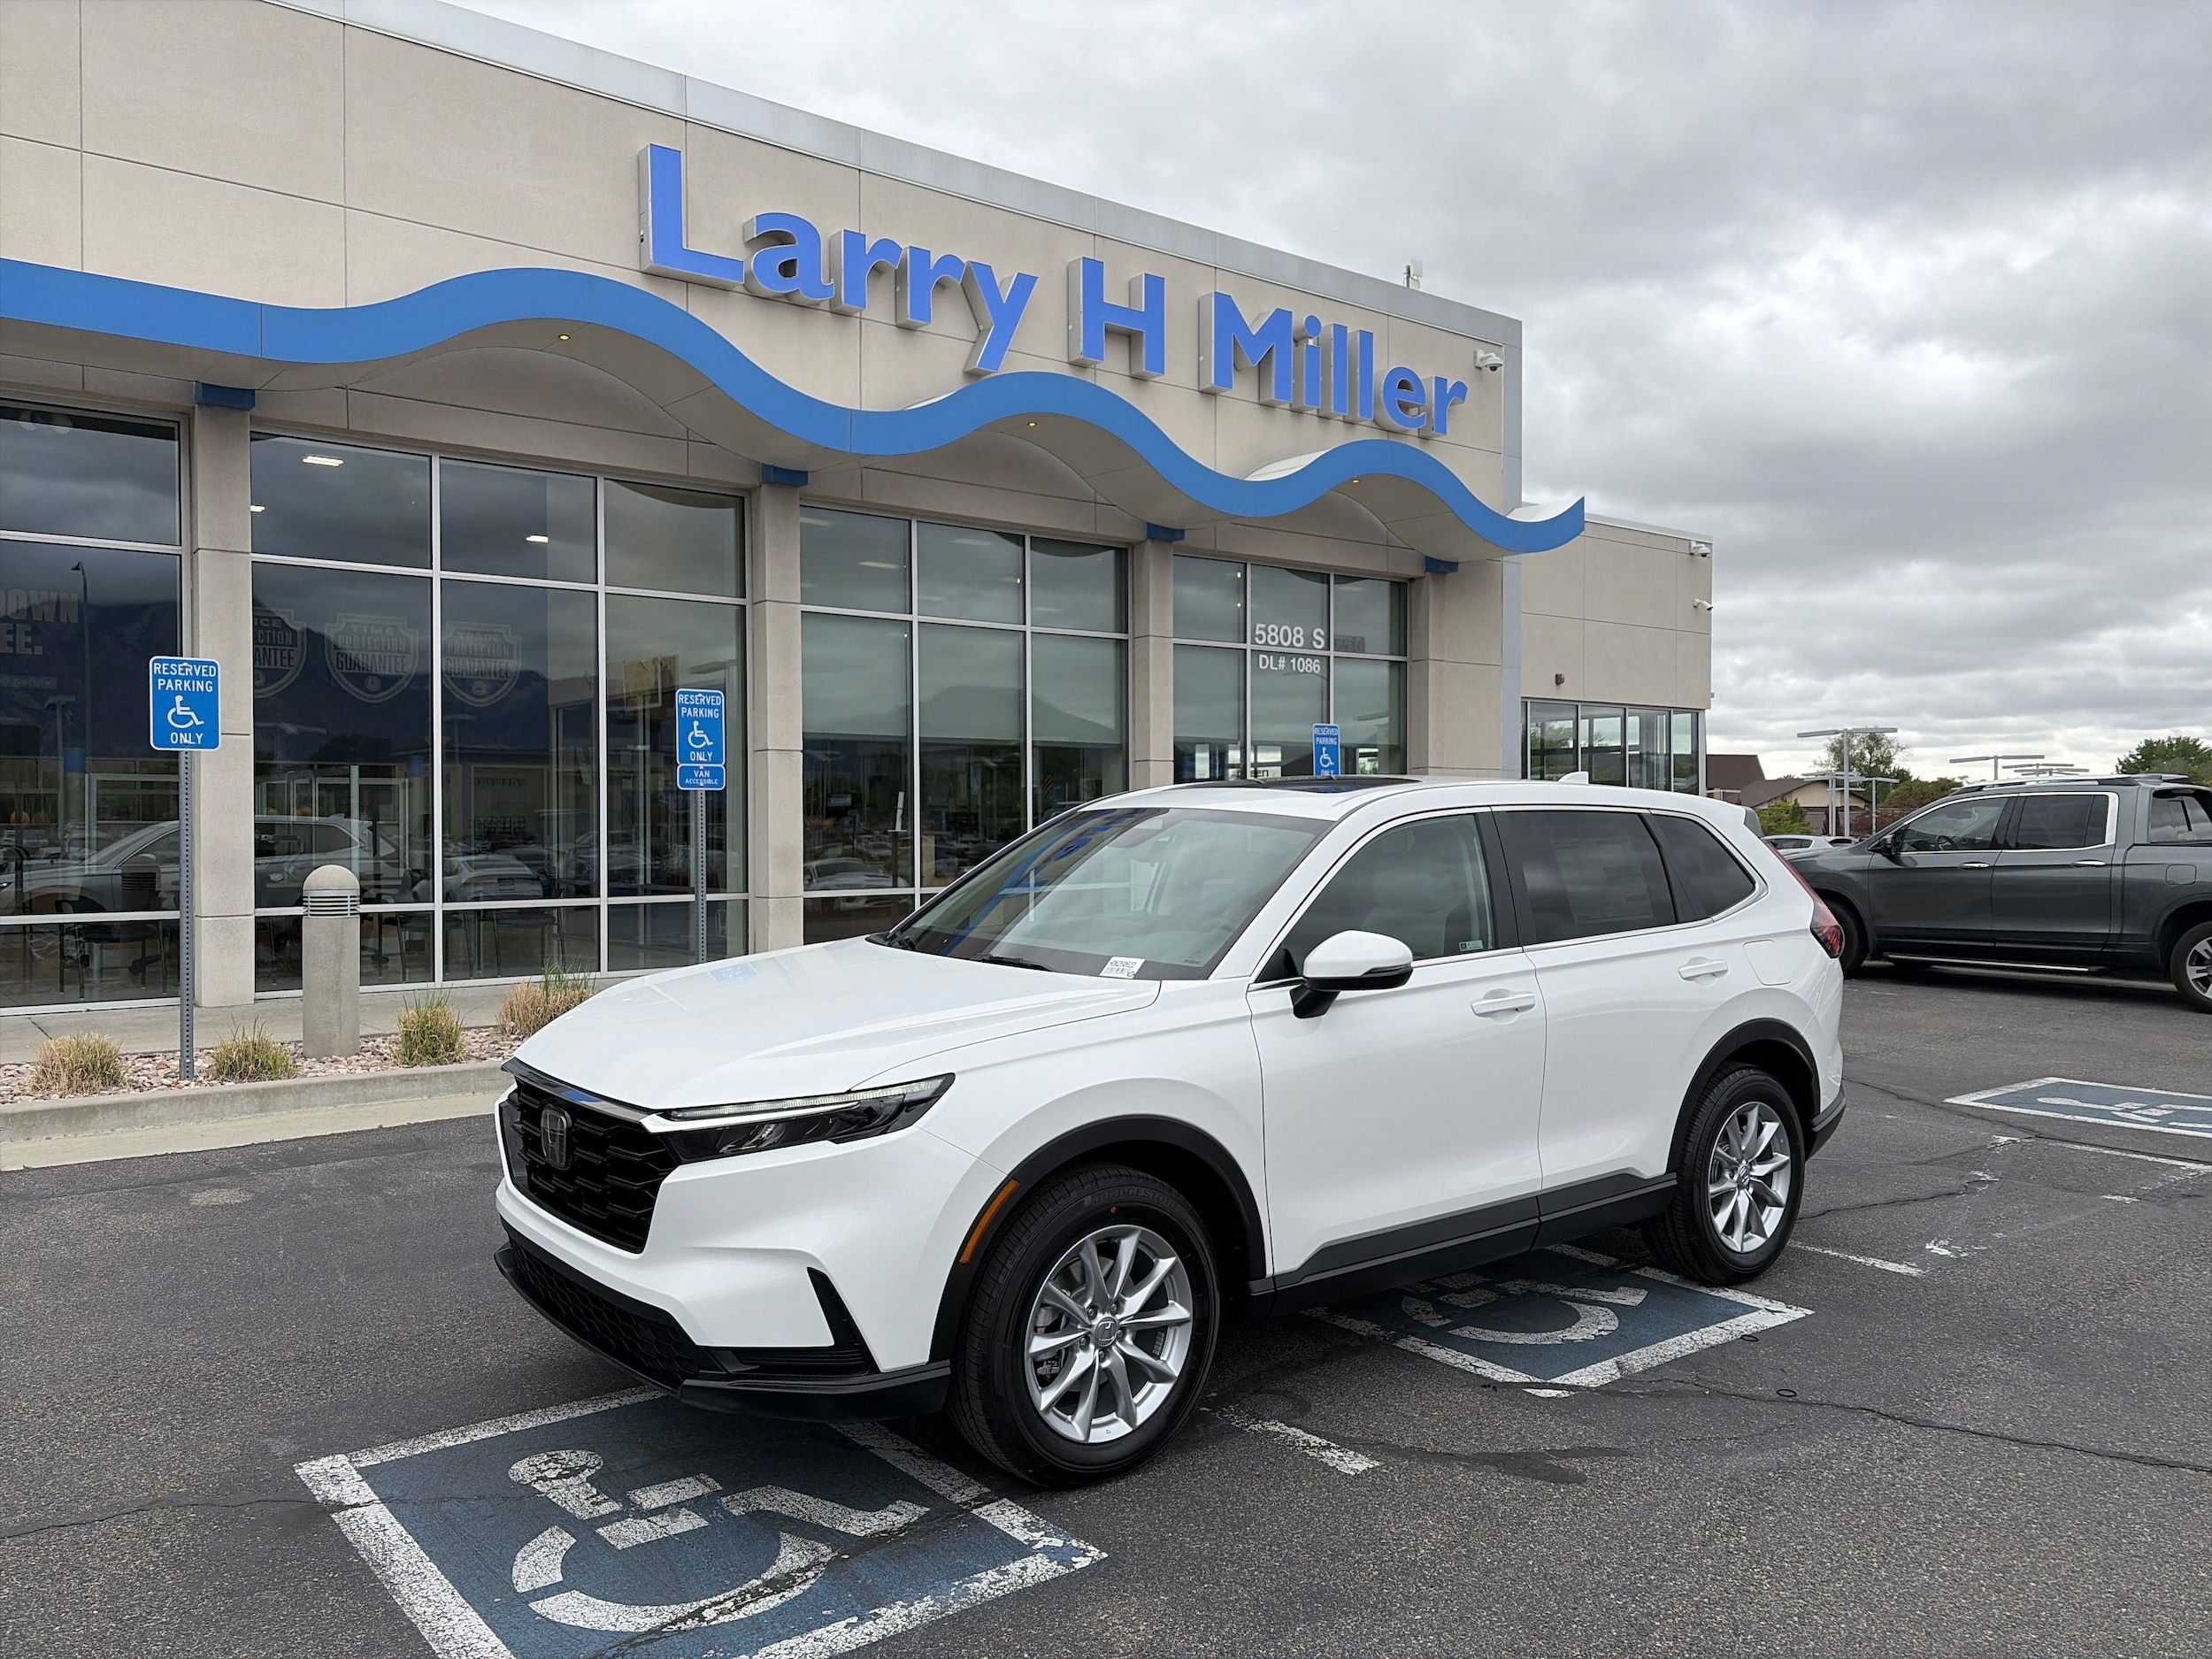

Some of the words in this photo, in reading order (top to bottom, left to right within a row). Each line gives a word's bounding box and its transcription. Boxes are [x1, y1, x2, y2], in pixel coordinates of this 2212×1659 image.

[640, 142, 1039, 375] Larry
[1069, 256, 1165, 379] H
[1200, 291, 1468, 437] Miller
[0, 588, 78, 623] OWN
[349, 624, 394, 634] TIME
[1255, 623, 1304, 648] 5808
[1312, 627, 1325, 649] S
[254, 629, 292, 645] CTION
[338, 634, 405, 651] PROTECTION
[446, 642, 510, 658] PROTECTION
[336, 651, 408, 674] GUARANTEE
[445, 658, 511, 679] GUARANTEE
[1258, 654, 1286, 671] DL#
[1290, 657, 1321, 673] 1086
[153, 663, 217, 677] RESERVED
[157, 679, 213, 693] PARKING
[679, 694, 722, 706] RESERVED
[681, 707, 719, 718] PARKING
[1314, 726, 1338, 736] RESERVED
[170, 732, 204, 745] ONLY
[1316, 736, 1338, 745] PARKING
[690, 751, 713, 762] ONLY
[693, 770, 710, 779] VAN
